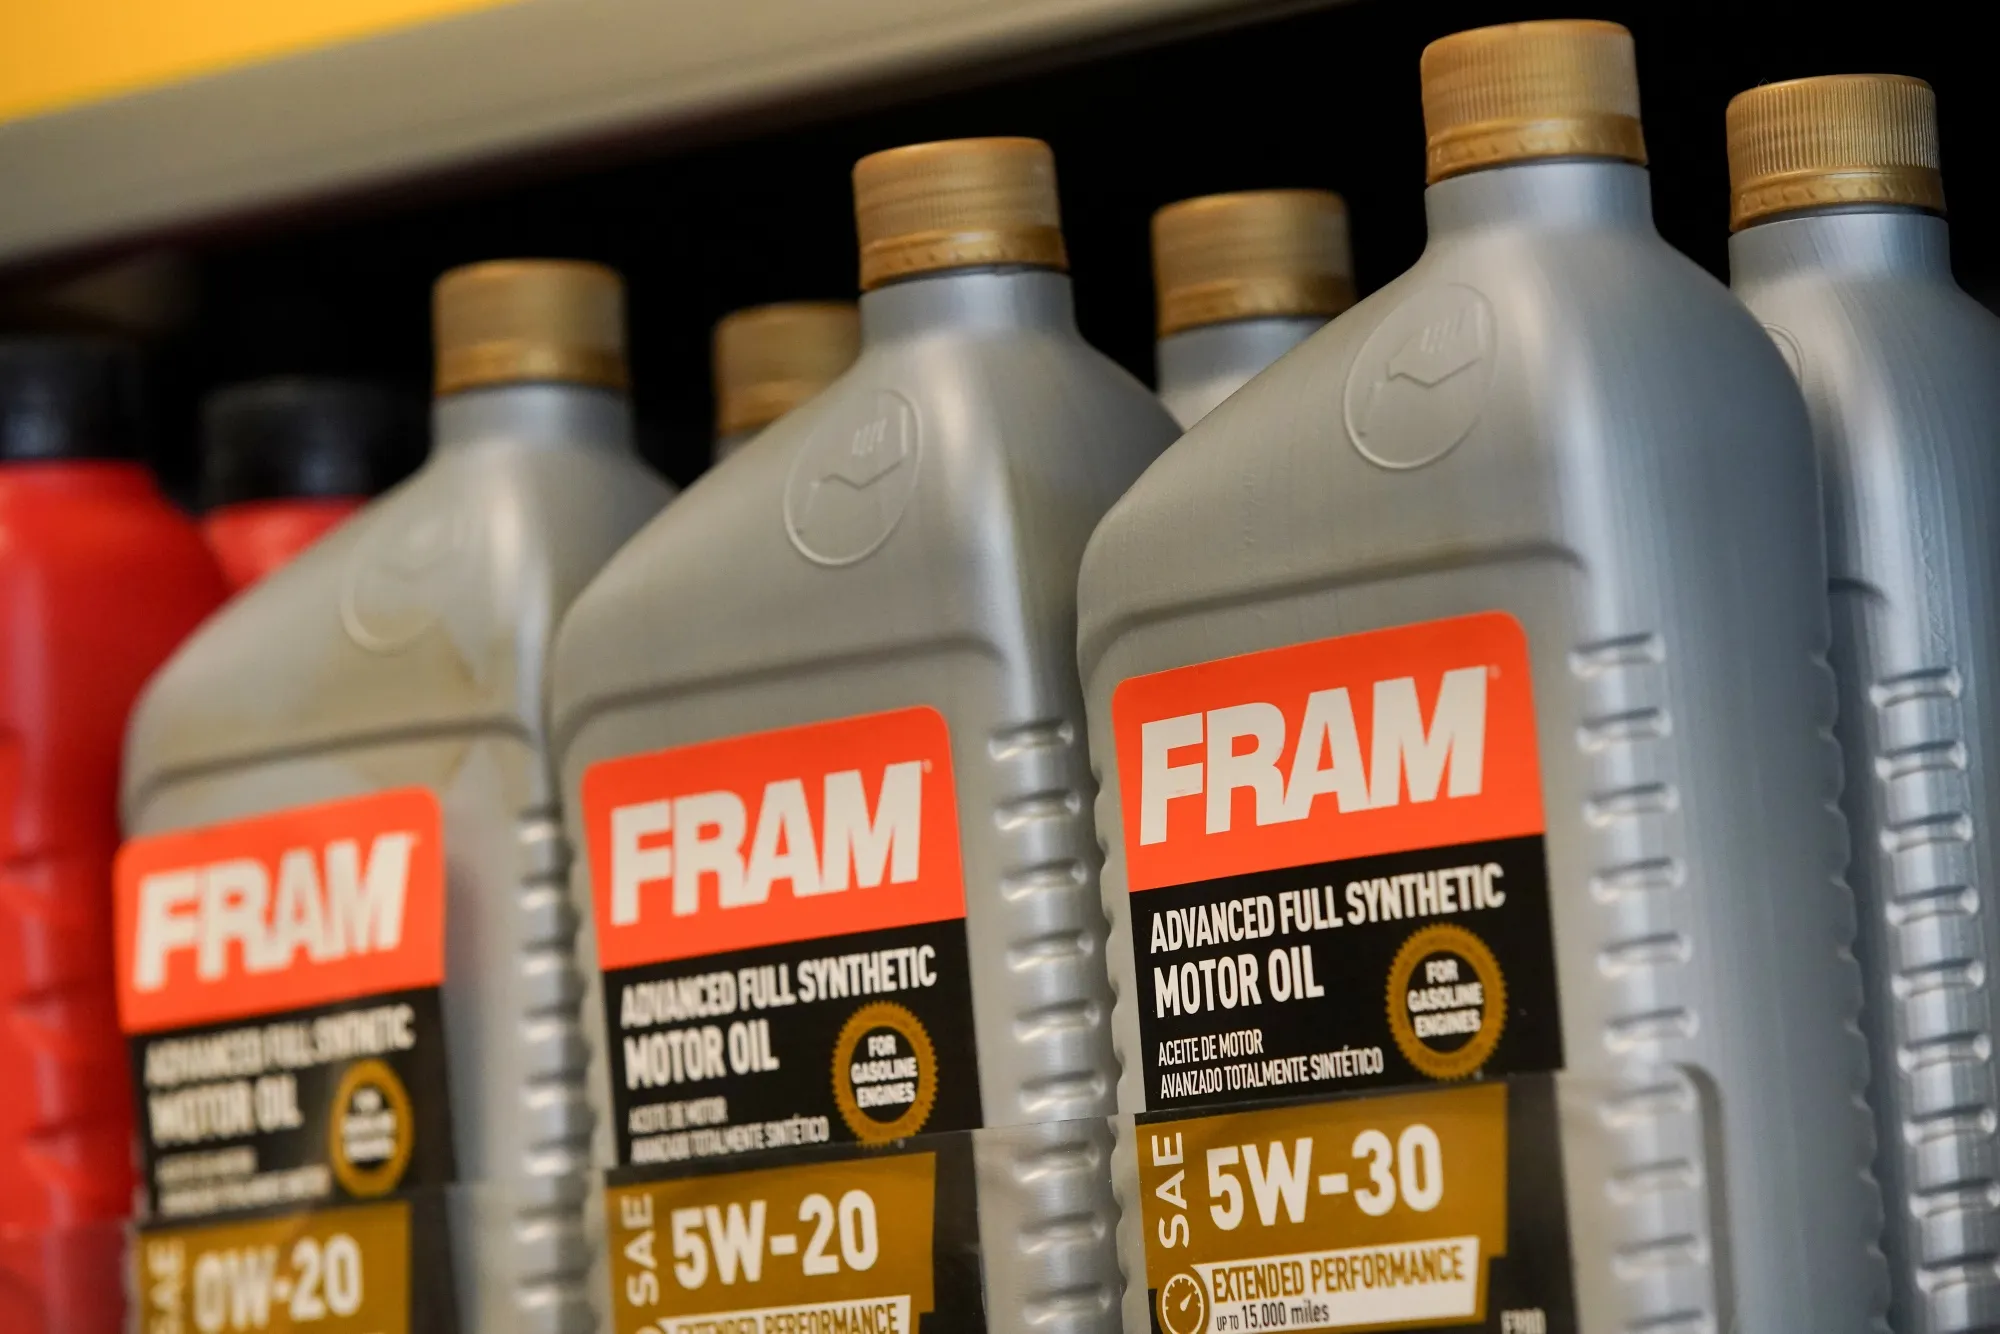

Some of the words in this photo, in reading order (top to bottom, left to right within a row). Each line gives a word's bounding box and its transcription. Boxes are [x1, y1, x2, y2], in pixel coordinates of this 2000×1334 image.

[1139, 665, 1488, 846] FRAM
[610, 759, 923, 928] FRAM
[132, 829, 414, 993] FRAM
[1150, 895, 1275, 954] ADVANCED
[1280, 885, 1344, 935] FULL
[1346, 862, 1507, 926] SYNTHETIC
[620, 970, 738, 1030] ADVANCED
[739, 962, 797, 1012] FULL
[797, 944, 938, 1004] SYNTHETIC
[1153, 952, 1262, 1019] MOTOR
[1268, 944, 1325, 1003] OIL
[1407, 981, 1484, 1013] GASOLINE
[1425, 958, 1460, 985] FOR
[622, 1024, 728, 1091] MOTOR
[728, 1017, 780, 1076] OIL
[867, 1033, 897, 1058] FOR
[1158, 1036, 1200, 1067] ACEITE
[1201, 1034, 1217, 1061] DE
[1219, 1028, 1264, 1060] MOTOR
[1413, 1008, 1482, 1039] ENGINES
[850, 1056, 919, 1084] GASOLINE
[856, 1081, 916, 1109] ENGINES
[1160, 1067, 1223, 1100] AVANZADO
[1223, 1055, 1310, 1091] TOTALMENTE
[1310, 1044, 1385, 1081] SINTÉTICO
[1151, 1131, 1191, 1249] SAE
[1205, 1122, 1444, 1232] 5W-30
[620, 1192, 660, 1307] SAE
[671, 1188, 880, 1291] 5W-20
[1211, 1260, 1305, 1305] EXTENDED
[1310, 1244, 1466, 1295] PERFORMANCE
[192, 1232, 365, 1333] 0W-20
[1216, 1315, 1229, 1332] UP
[1228, 1313, 1240, 1331] TO
[1241, 1301, 1288, 1329] 15,000
[1290, 1298, 1330, 1326] miles
